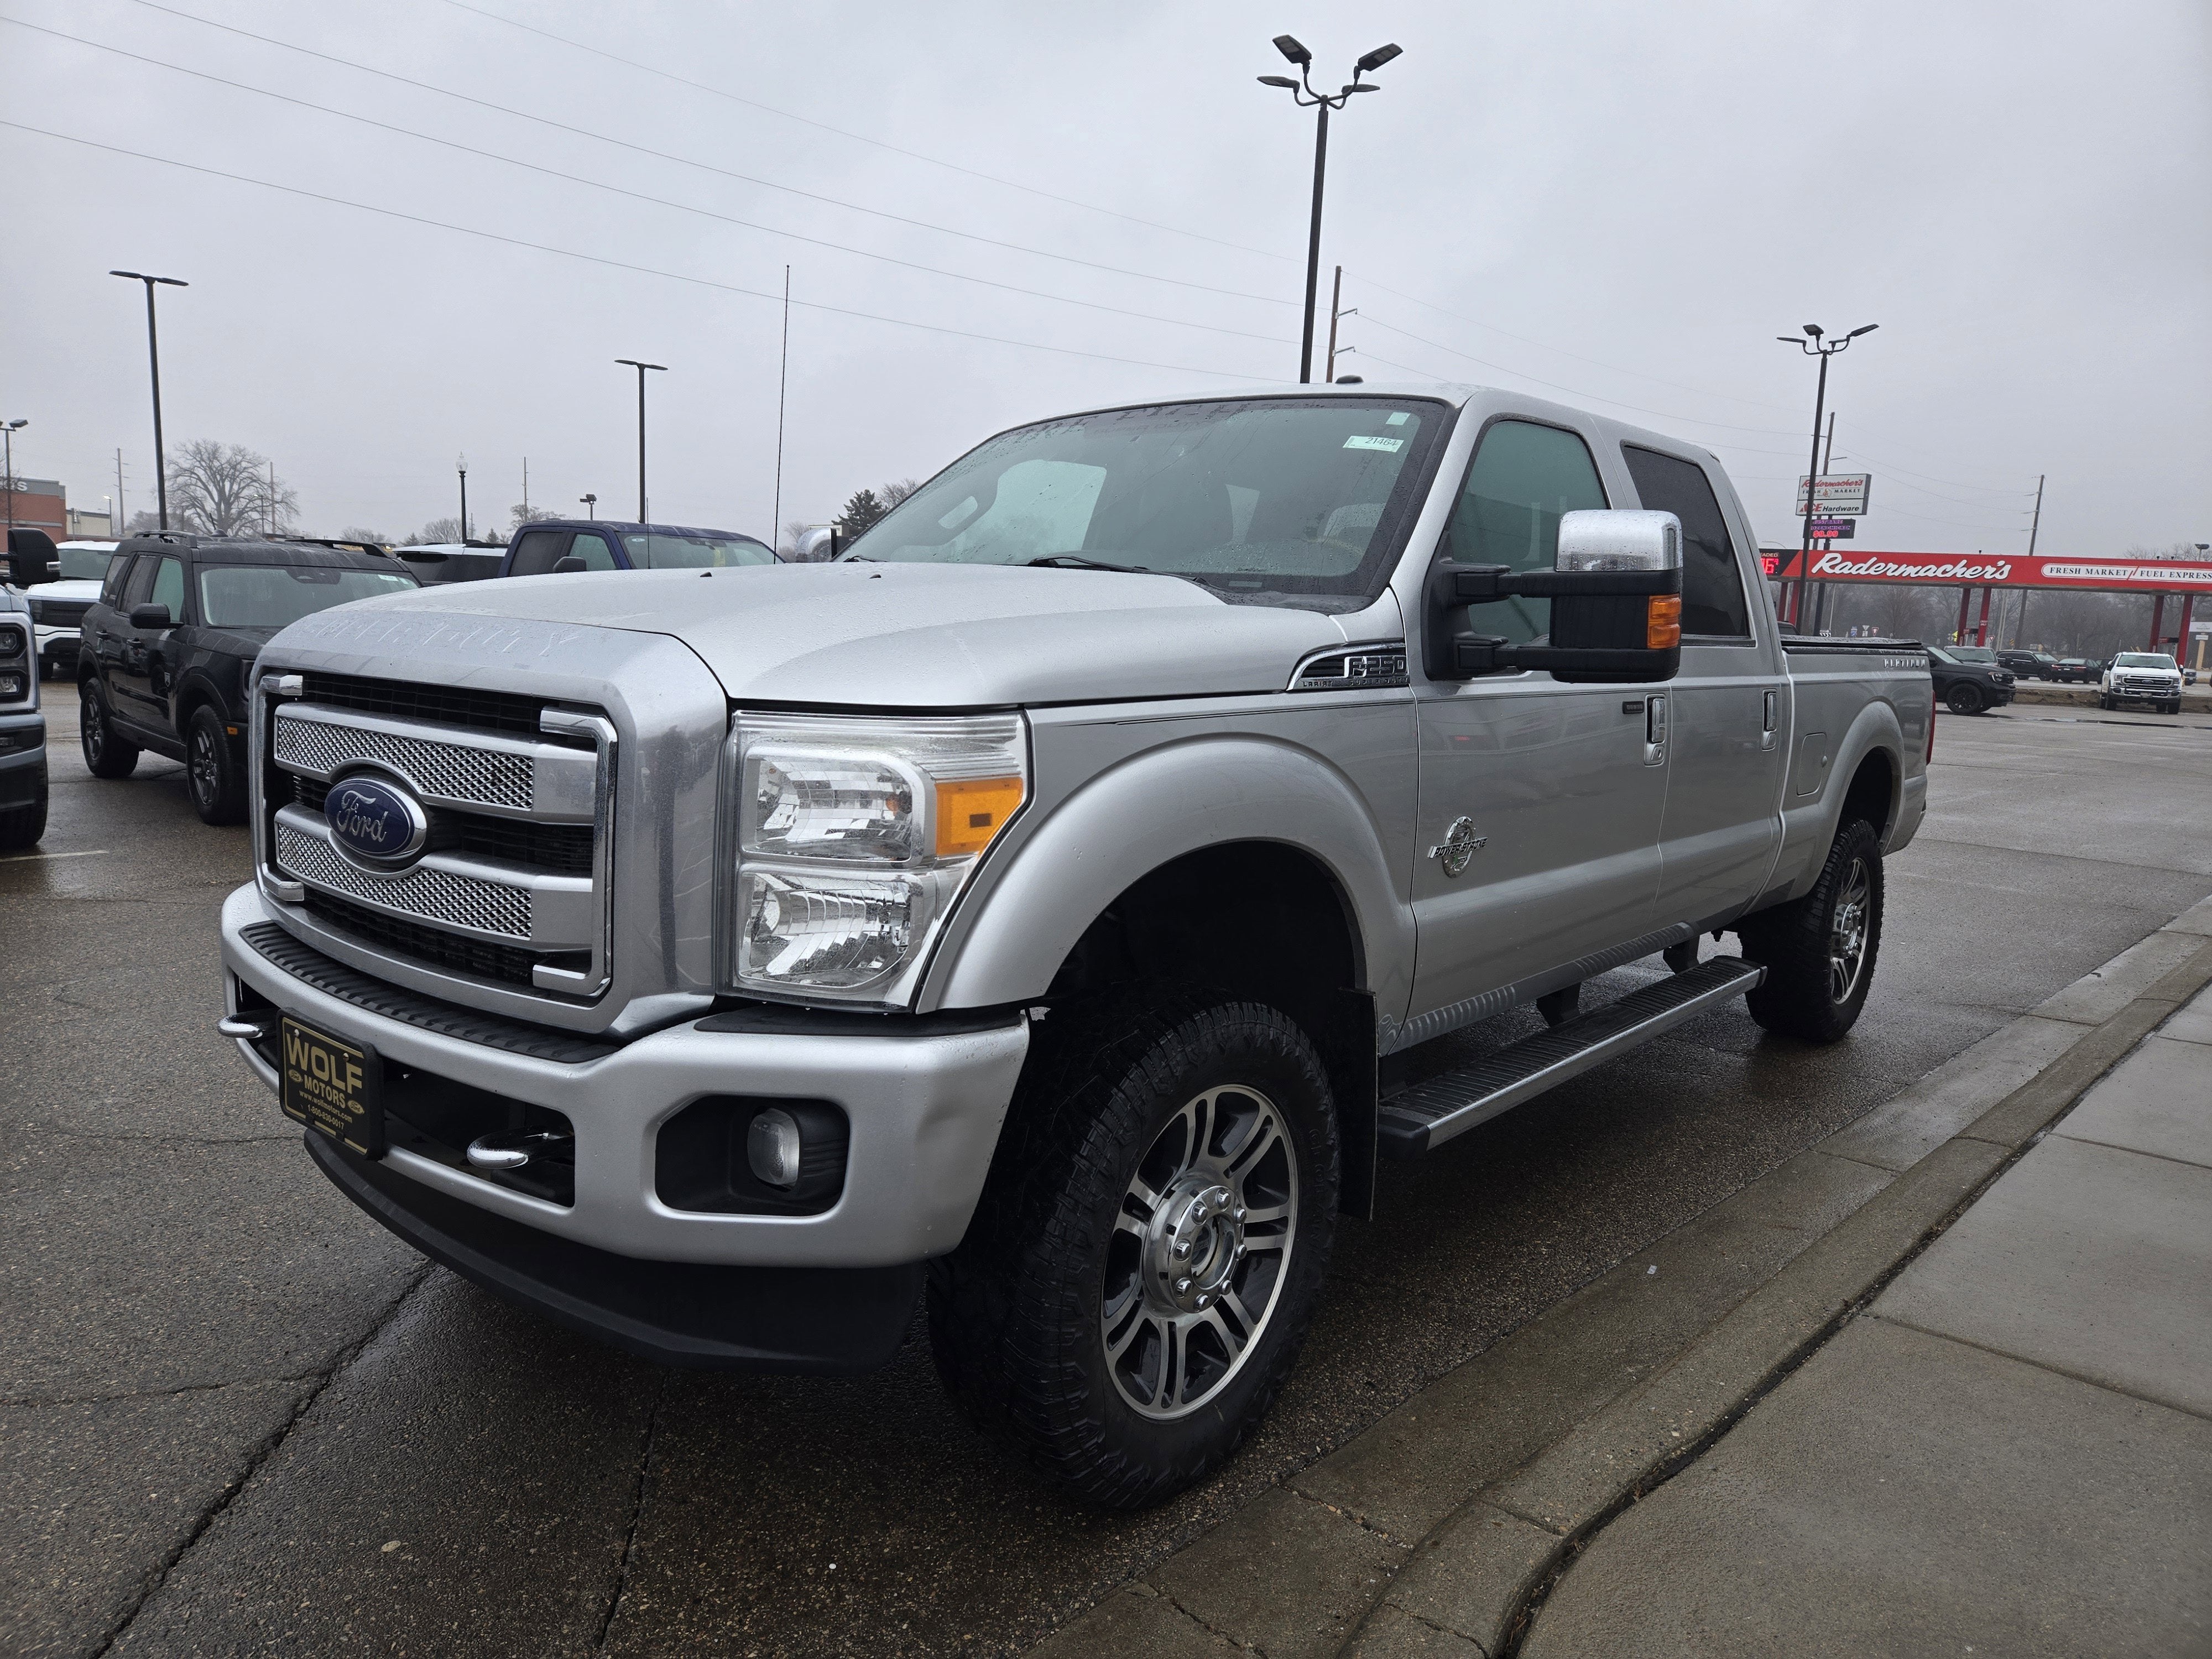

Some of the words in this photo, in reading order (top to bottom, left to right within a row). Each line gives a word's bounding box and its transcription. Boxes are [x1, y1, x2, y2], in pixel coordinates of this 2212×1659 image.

[1365, 437, 1397, 446] 21464
[1802, 479, 1864, 488] Rdermacher's
[1812, 553, 2012, 580] Radermacher's
[2169, 571, 2212, 580] EXPRESS
[337, 790, 388, 842] Ford
[286, 1032, 362, 1094] WOLF
[299, 1090, 352, 1123] www.wolfmotors.com
[305, 1074, 346, 1109] MOTORS
